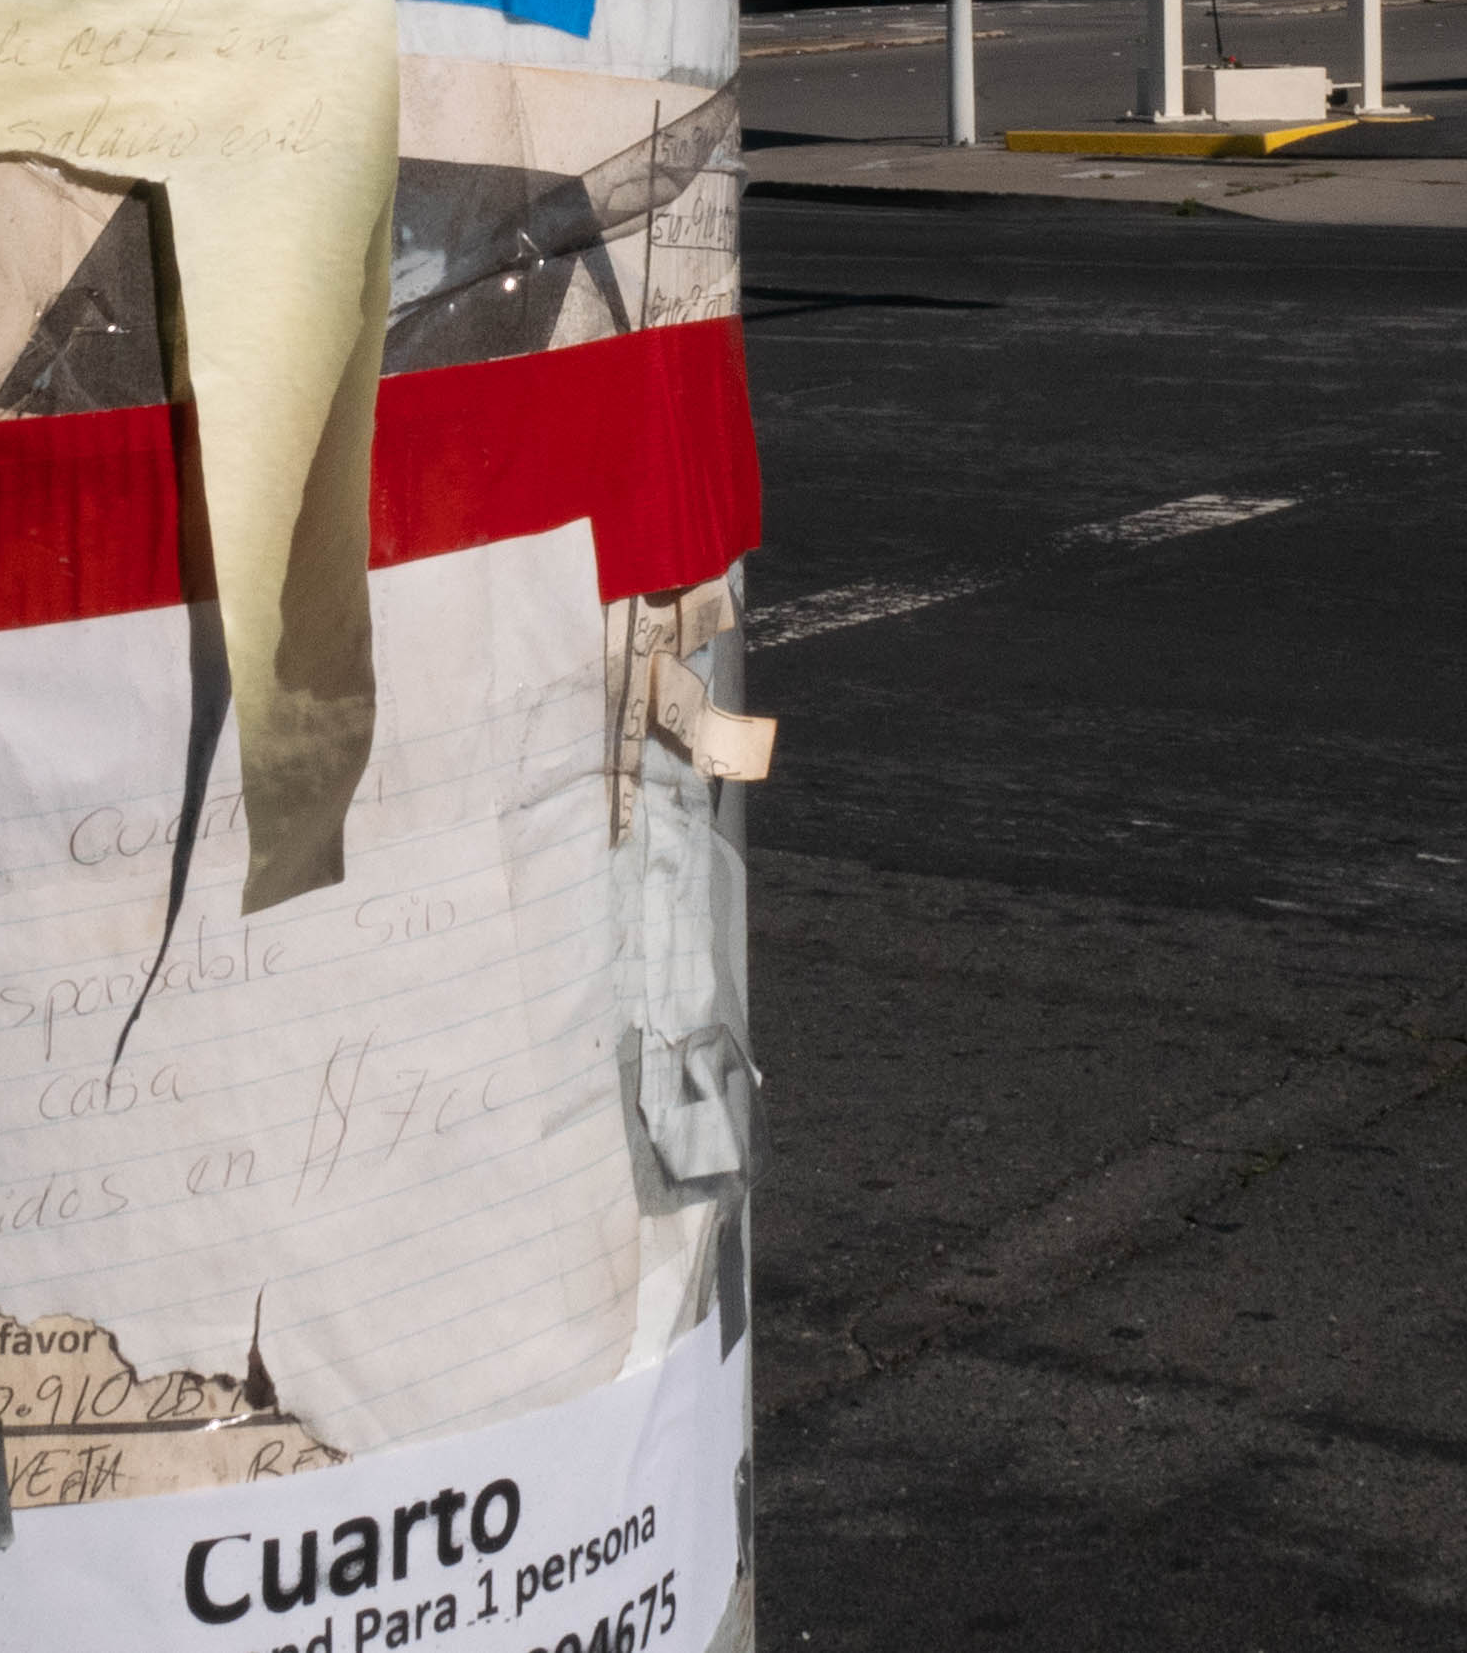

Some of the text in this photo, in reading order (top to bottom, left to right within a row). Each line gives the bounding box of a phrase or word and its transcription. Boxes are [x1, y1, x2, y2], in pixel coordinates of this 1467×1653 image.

[185, 1478, 521, 1625] Cuarto
[356, 1593, 456, 1653] Para
[478, 1568, 499, 1620] 1
[516, 1504, 656, 1619] persona
